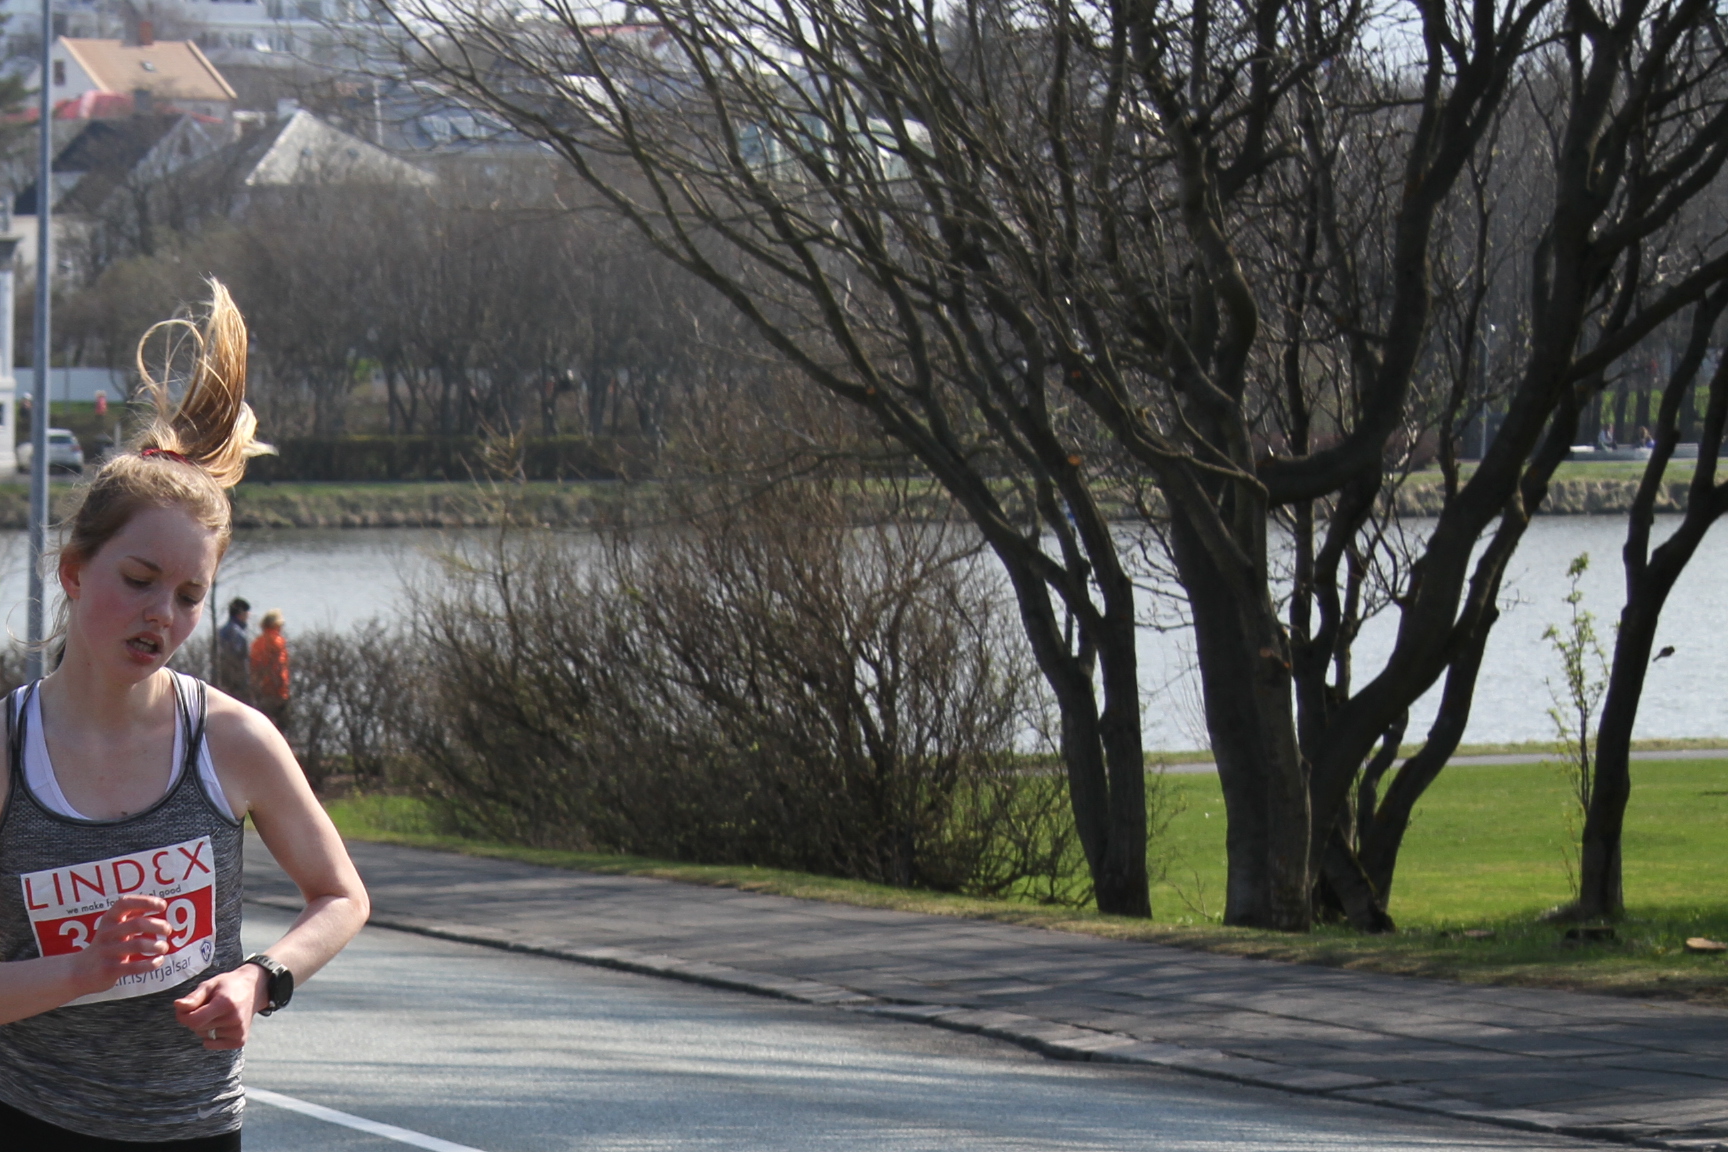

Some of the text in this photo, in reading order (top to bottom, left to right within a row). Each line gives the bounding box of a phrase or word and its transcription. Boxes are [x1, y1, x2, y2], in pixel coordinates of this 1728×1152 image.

[25, 841, 211, 910] LINDEX
[81, 902, 105, 913] make
[158, 884, 182, 898] good
[58, 898, 197, 954] 39
